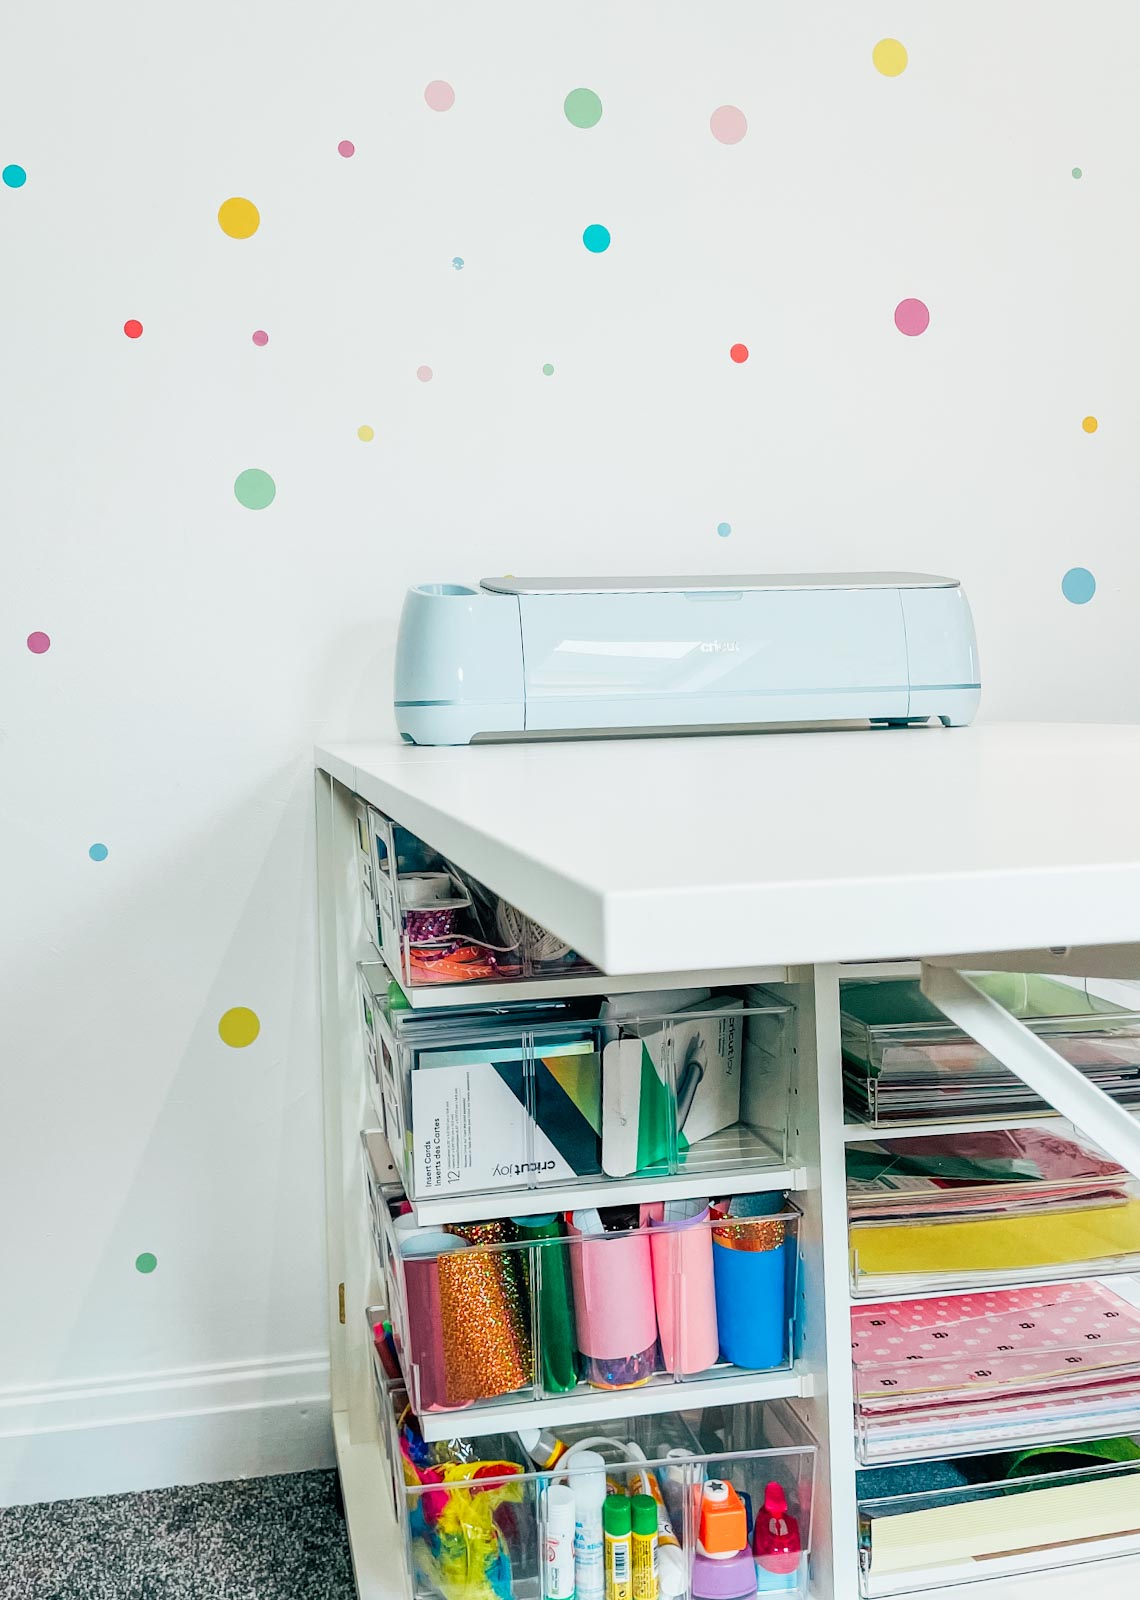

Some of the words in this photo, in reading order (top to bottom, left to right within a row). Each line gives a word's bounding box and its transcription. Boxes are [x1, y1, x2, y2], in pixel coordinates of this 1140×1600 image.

[433, 1118, 441, 1144] Cartes
[424, 1141, 432, 1164] Cards
[424, 1165, 432, 1187] Insert
[434, 1161, 442, 1186] Inserts
[447, 1170, 460, 1185] 12
[492, 1163, 513, 1177] joy
[514, 1160, 556, 1176] cricut
